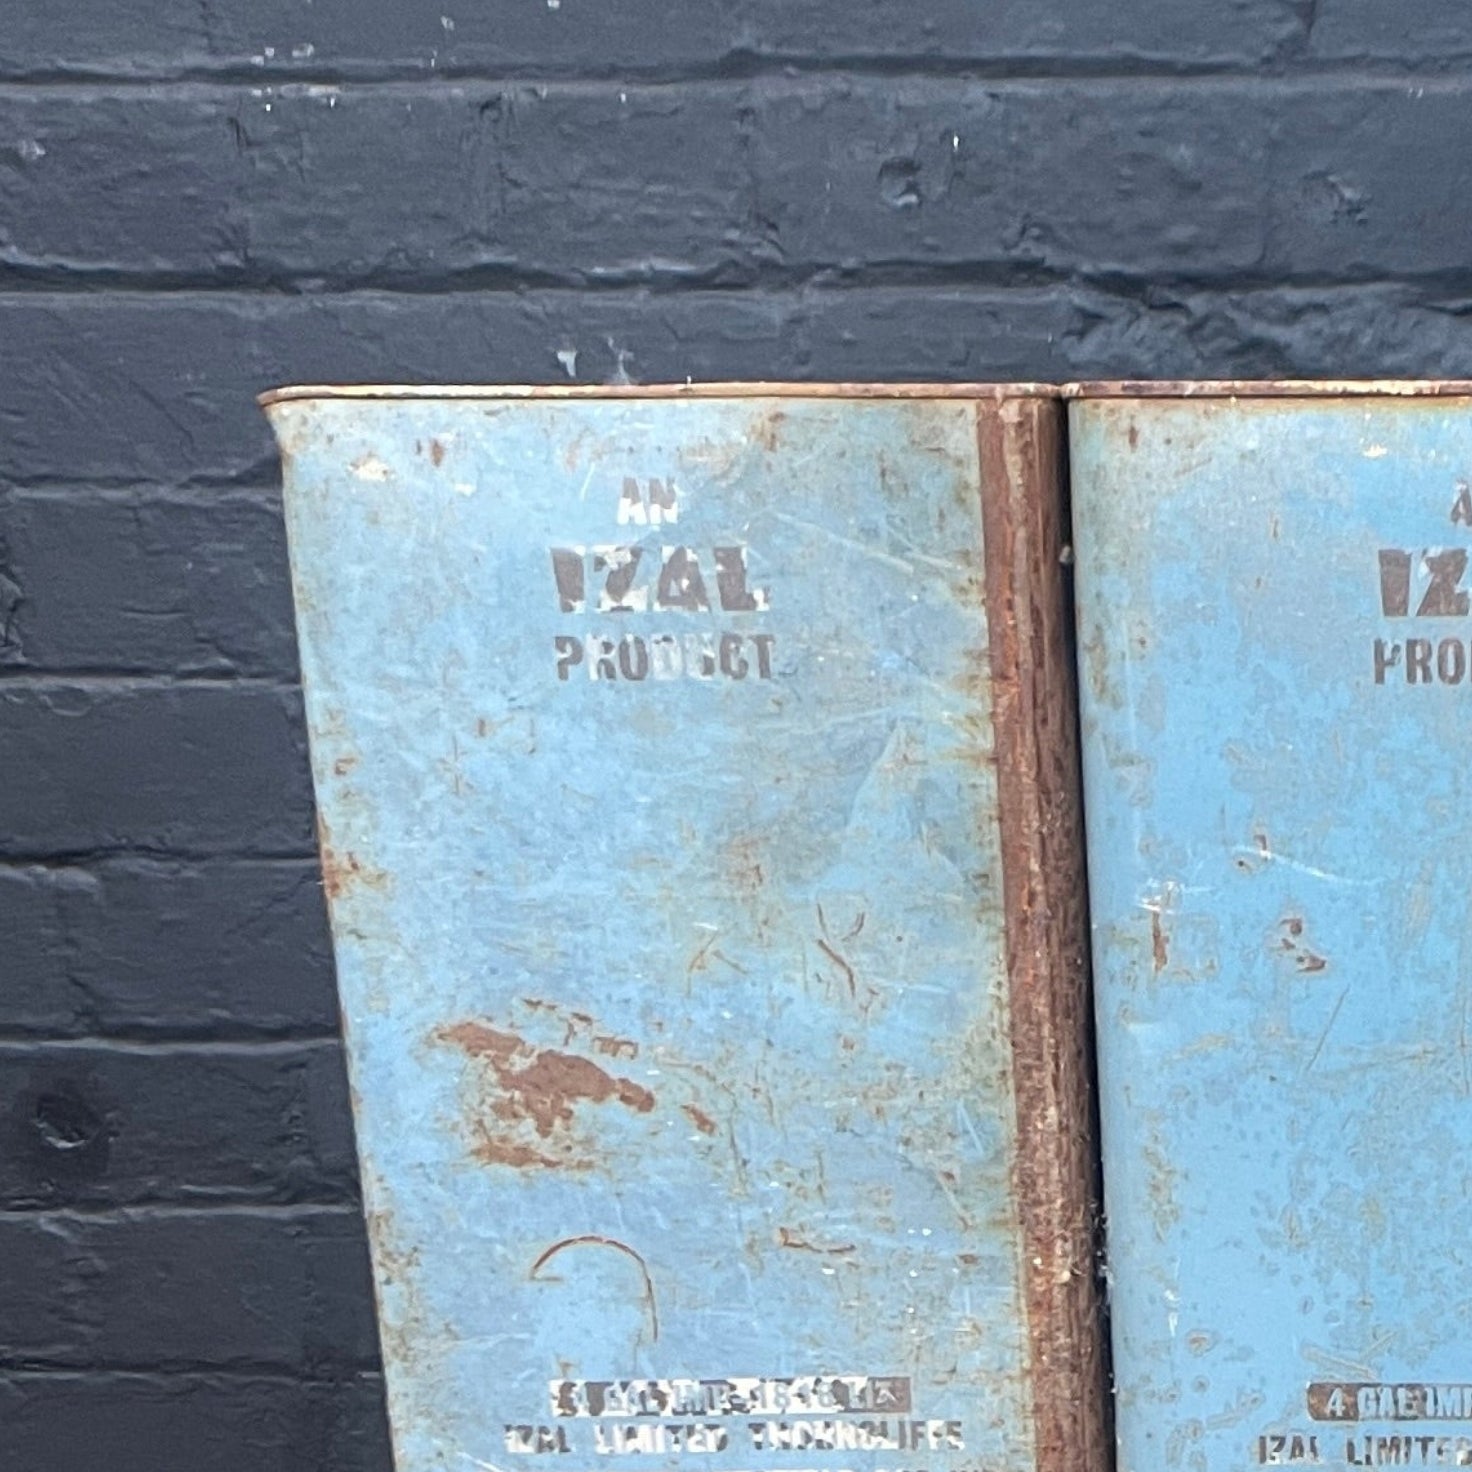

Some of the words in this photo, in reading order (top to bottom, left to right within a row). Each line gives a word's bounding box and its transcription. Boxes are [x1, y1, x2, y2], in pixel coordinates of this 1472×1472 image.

[617, 477, 678, 525] AN
[551, 545, 770, 614] IZAL
[554, 632, 775, 682] PRODUCT
[1325, 1387, 1346, 1417] 4
[504, 1424, 575, 1453] IZAL
[594, 1424, 728, 1454] LIMITED
[1259, 1435, 1323, 1465] IZAL
